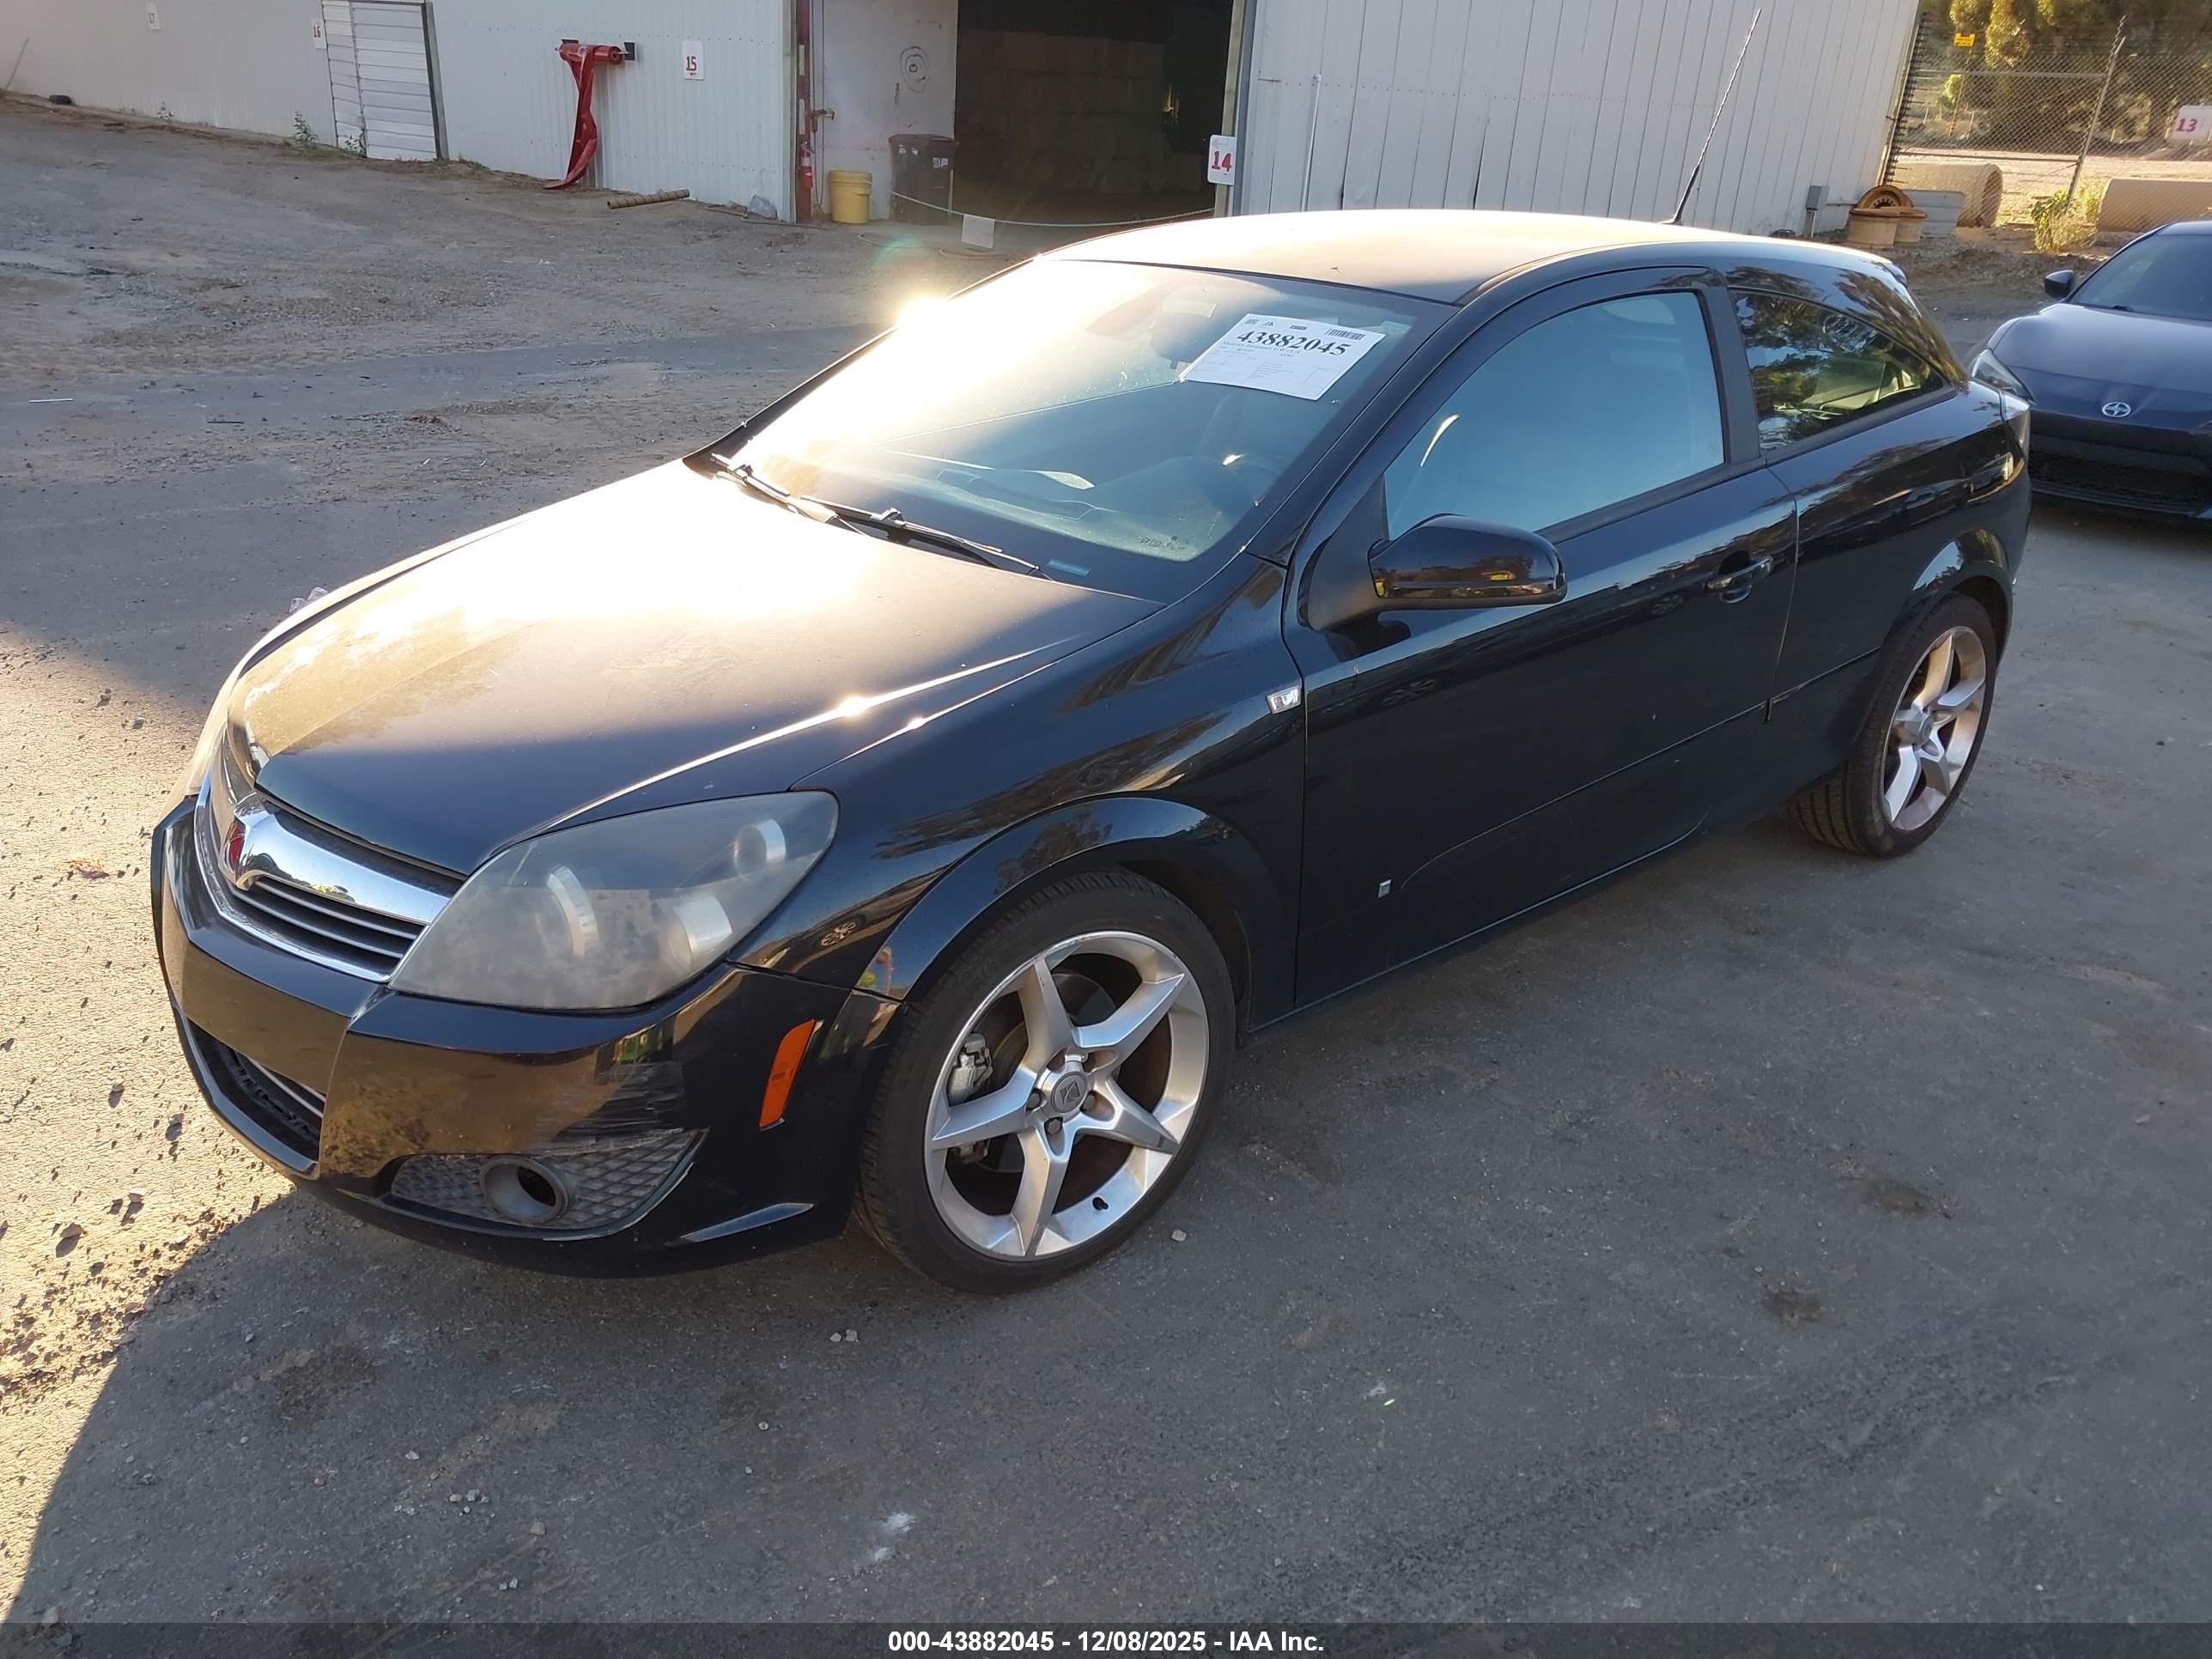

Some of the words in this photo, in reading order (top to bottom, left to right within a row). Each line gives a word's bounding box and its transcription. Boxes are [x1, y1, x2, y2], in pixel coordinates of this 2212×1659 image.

[686, 55, 697, 71] 15
[2175, 117, 2198, 132] 13
[1211, 150, 1232, 173] 14
[1236, 330, 1352, 356] 43882045
